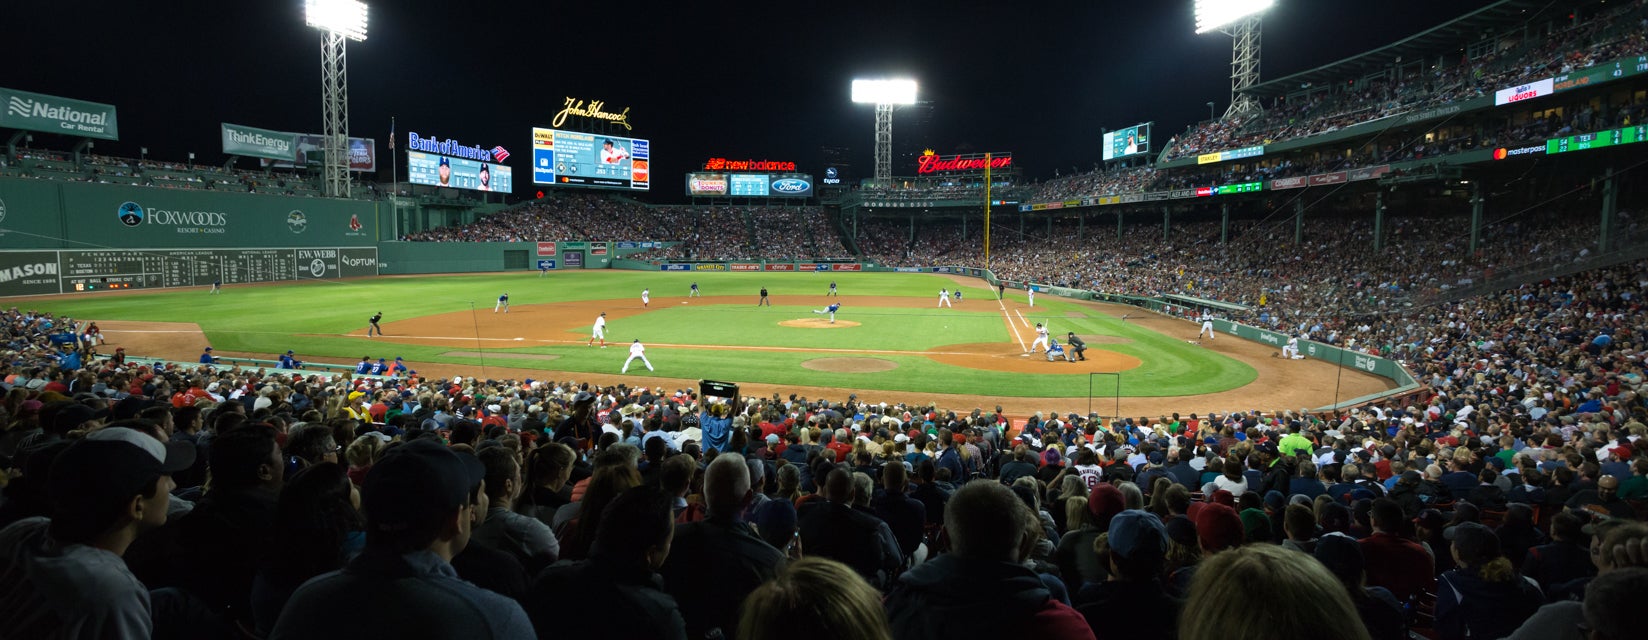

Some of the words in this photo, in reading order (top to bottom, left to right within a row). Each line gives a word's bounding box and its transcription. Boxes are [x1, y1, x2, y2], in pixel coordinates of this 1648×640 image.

[1508, 90, 1537, 102] LIQUORS
[32, 101, 107, 126] National
[551, 96, 588, 128] John
[588, 99, 632, 131] Hancock
[60, 121, 76, 130] Car
[77, 123, 104, 133] Rental
[408, 131, 440, 154] Bank
[441, 138, 452, 155] of
[451, 140, 491, 162] America
[1507, 144, 1546, 156] masterpass
[726, 160, 749, 171] new
[749, 158, 795, 171] balance
[918, 154, 1012, 174] Budweier
[463, 178, 468, 187] 2
[779, 180, 802, 191] Ford
[147, 207, 227, 226] FOXWOODS
[313, 250, 336, 259] WEBB
[350, 258, 376, 267] OPTUM
